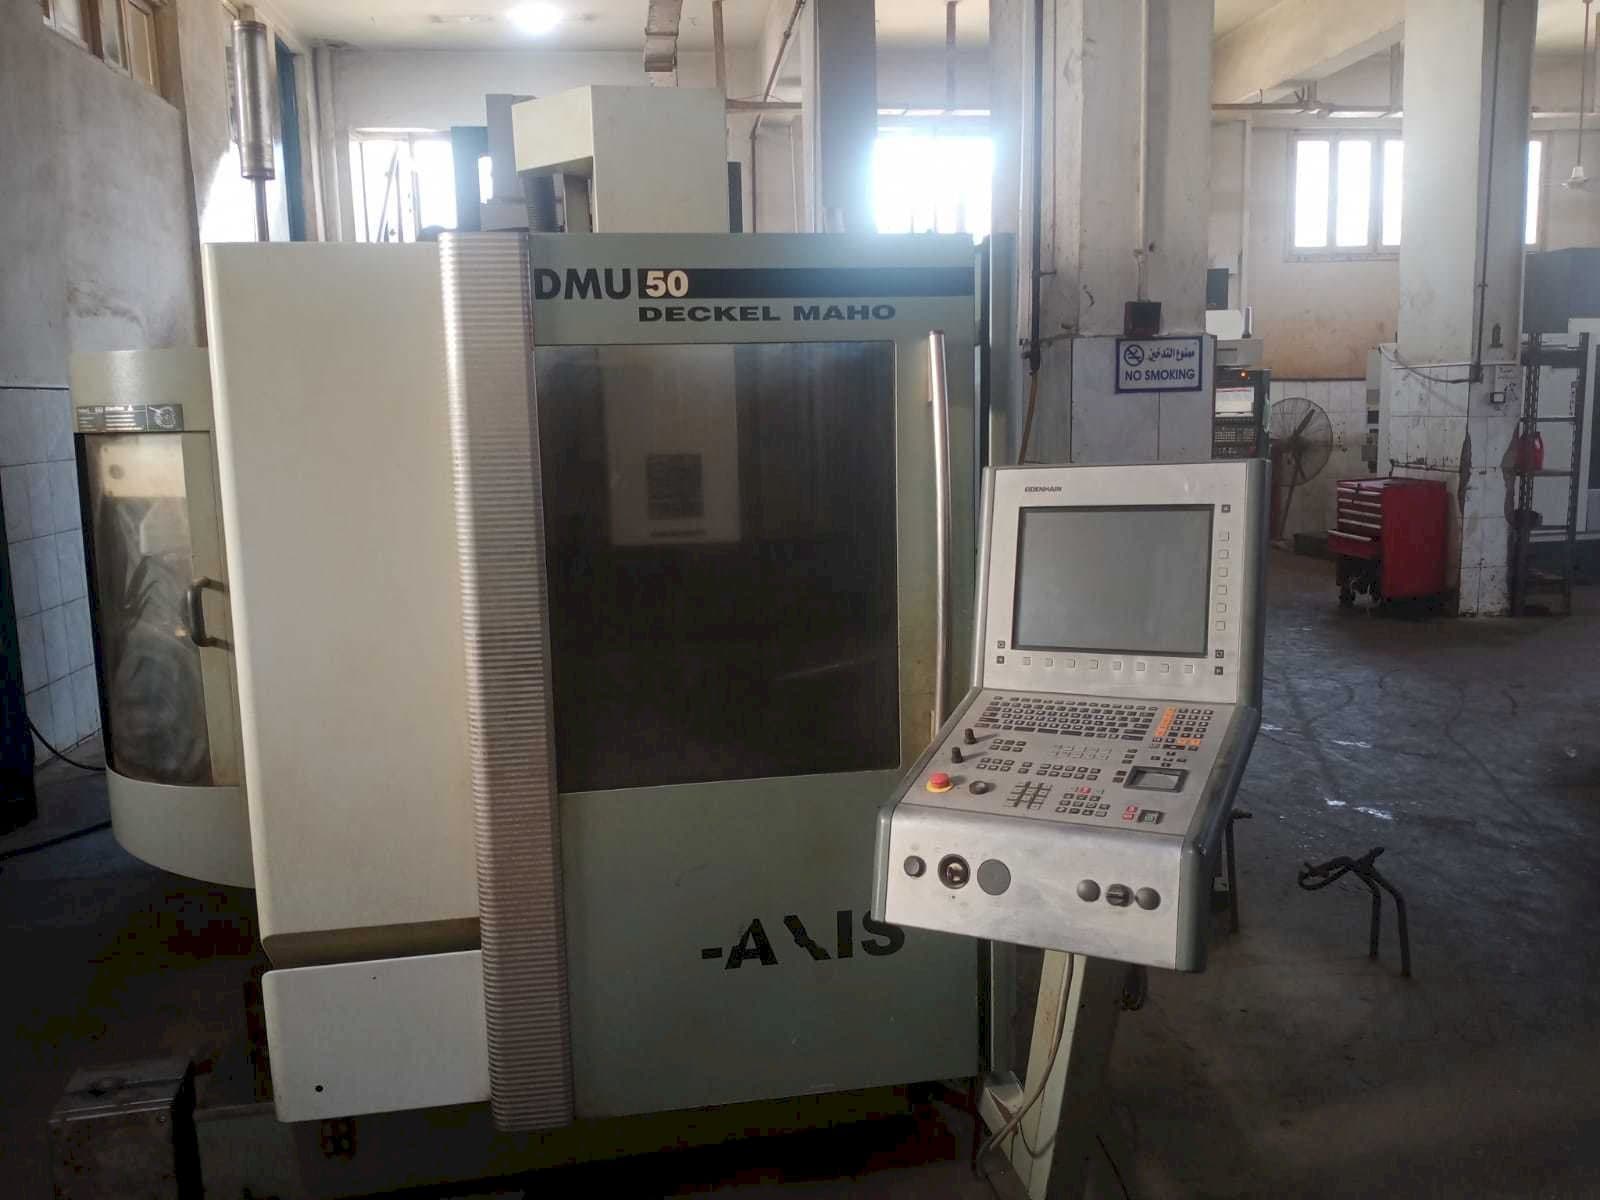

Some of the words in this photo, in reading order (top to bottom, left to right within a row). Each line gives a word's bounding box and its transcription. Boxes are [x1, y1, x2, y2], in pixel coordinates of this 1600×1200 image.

[534, 268, 631, 300] DMU
[645, 270, 689, 298] 50
[638, 306, 781, 322] DECKEL
[793, 304, 896, 321] MAHO
[1125, 370, 1142, 381] NO
[1145, 368, 1195, 381] SMOKING
